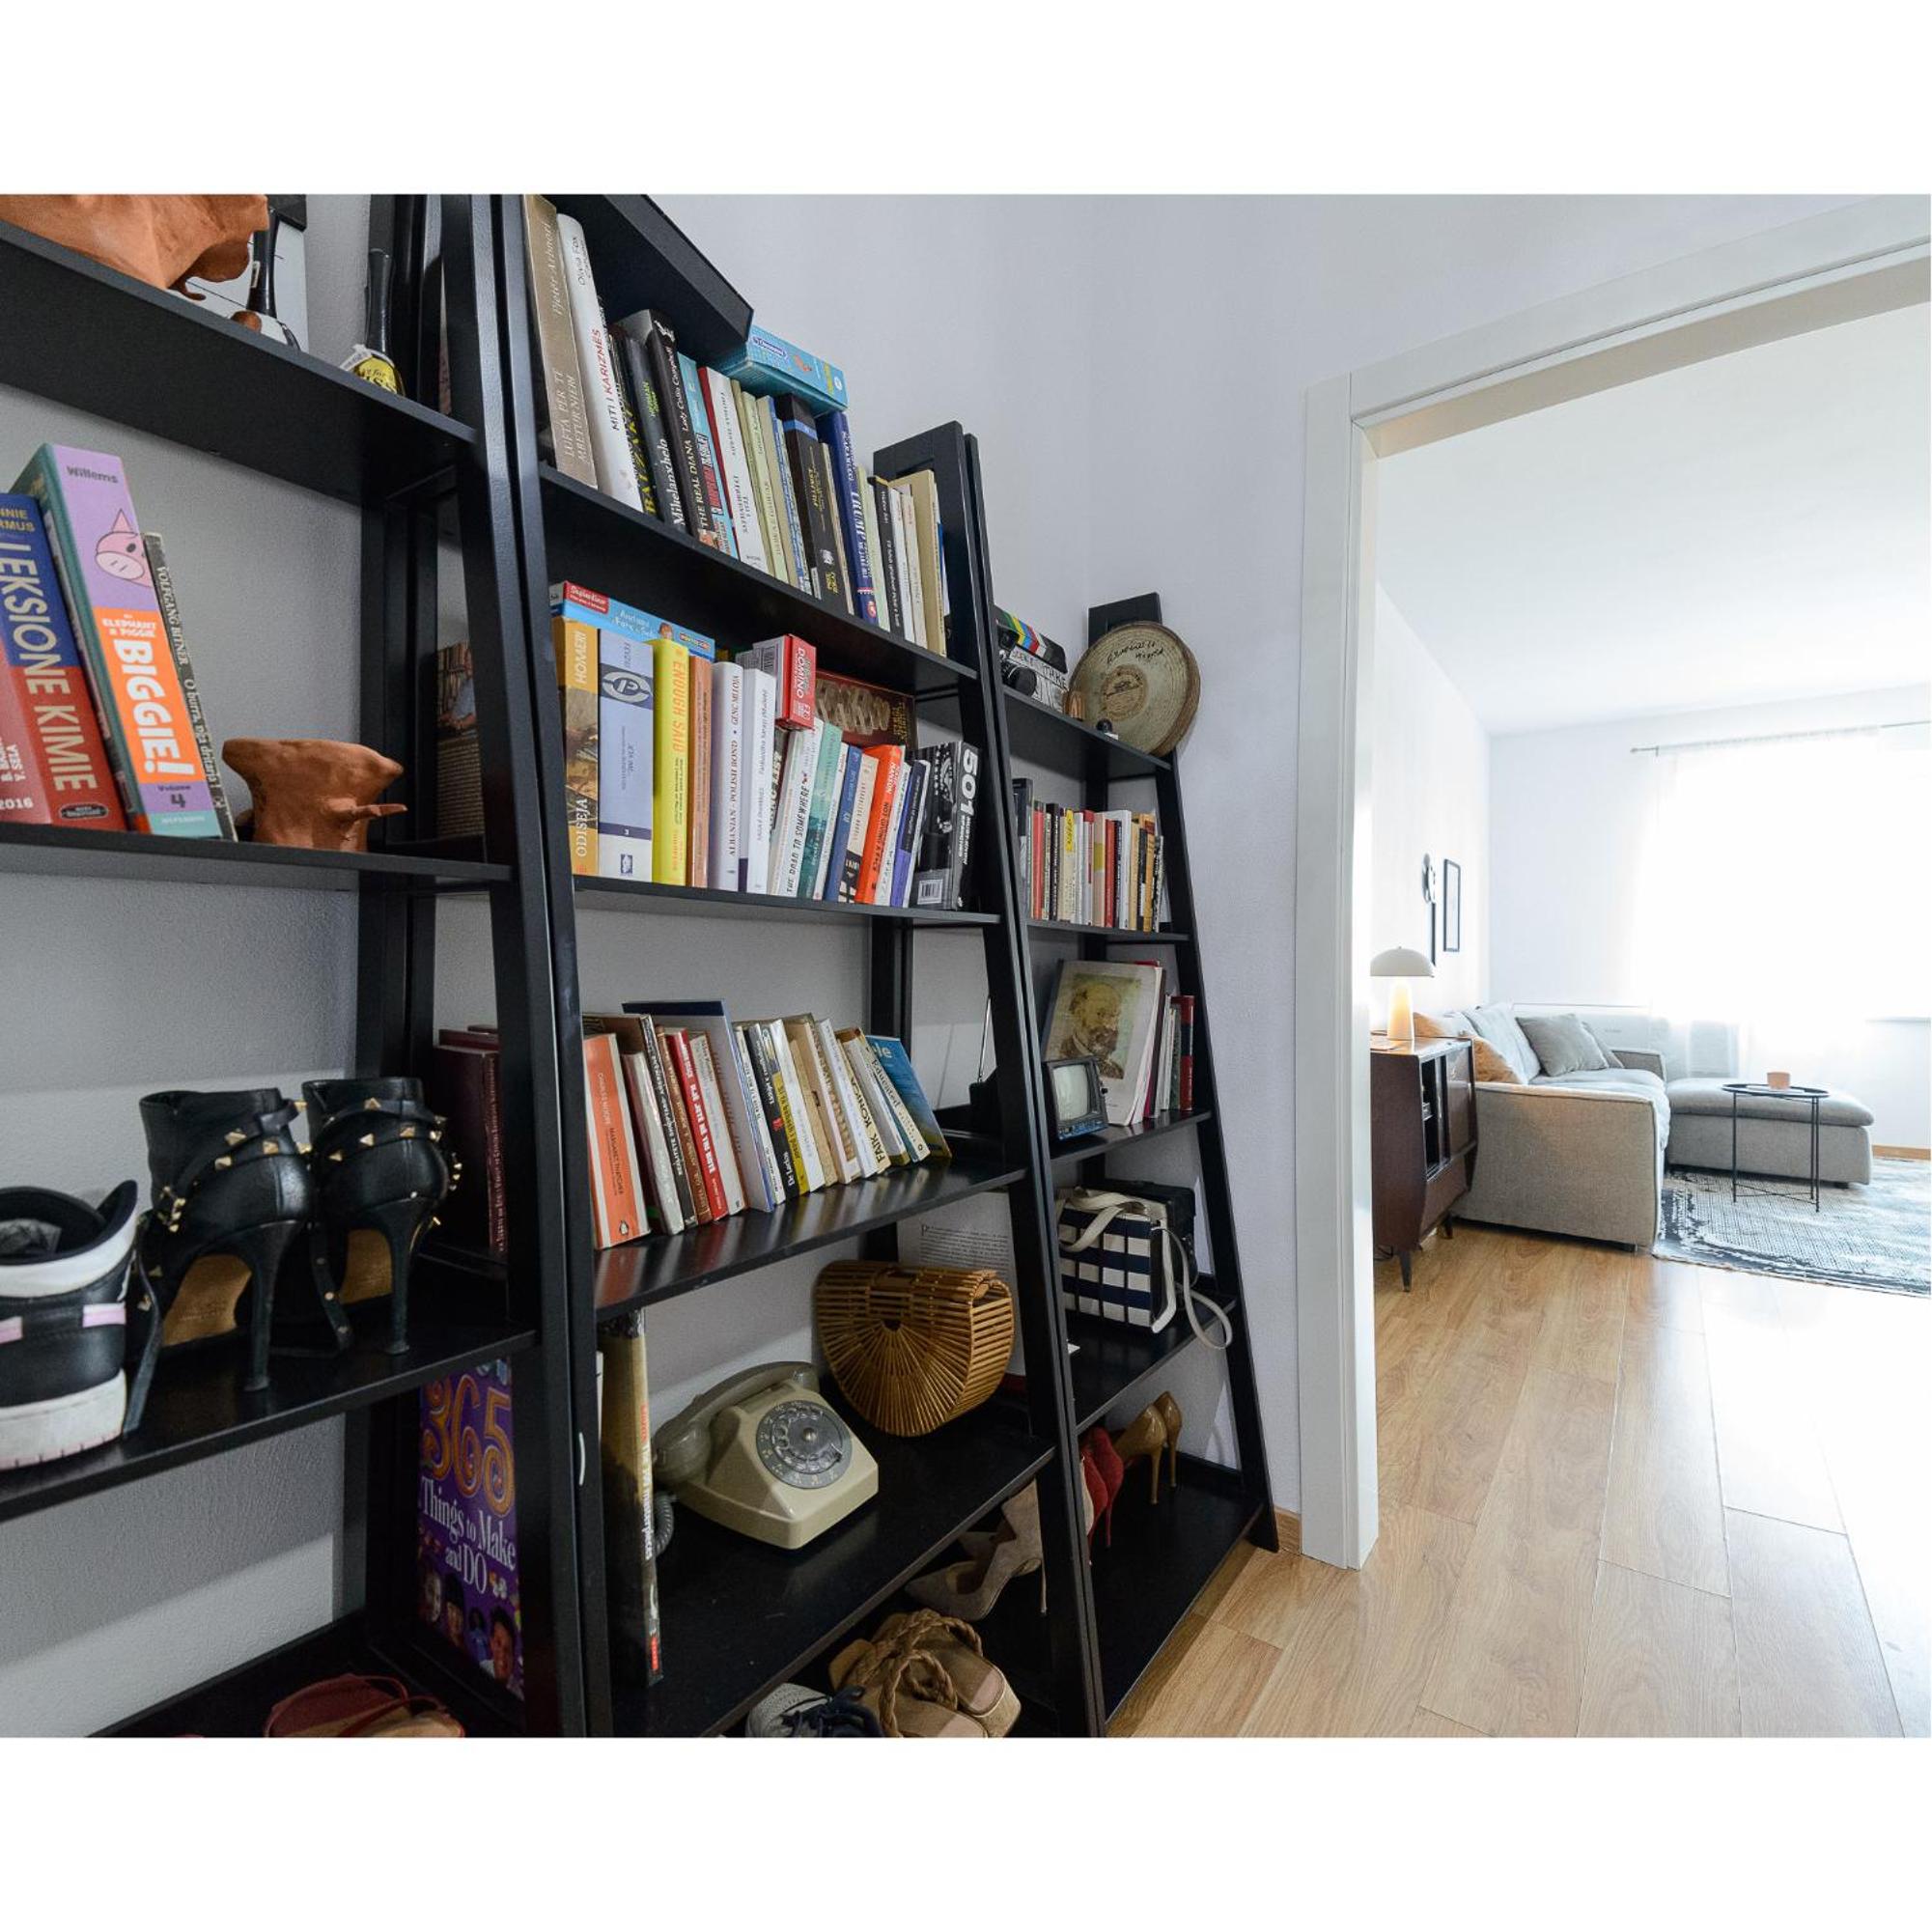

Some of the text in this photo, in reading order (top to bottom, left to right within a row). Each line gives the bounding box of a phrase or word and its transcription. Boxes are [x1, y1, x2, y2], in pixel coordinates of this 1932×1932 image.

[590, 328, 614, 395] KARIZMËS
[559, 417, 574, 458] LUFTA
[605, 404, 621, 432] MITI
[66, 465, 119, 484] Willems
[683, 438, 699, 475] DIANA
[689, 475, 704, 504] REAL
[850, 490, 867, 541] TRUMP
[694, 505, 709, 529] THE
[155, 565, 180, 627] VOLFGANG
[169, 626, 190, 666] BITNER
[574, 630, 588, 685] HOMERI
[796, 646, 805, 699] DOMINO
[114, 638, 196, 776] BIGGIE!
[672, 660, 686, 753] ENOUGH SAID
[34, 705, 98, 792] KIMIE
[0, 798, 34, 811] 2016
[171, 794, 185, 808] 4
[729, 739, 739, 857] ALBANIAN POLISH BOND
[961, 748, 978, 816] 501
[575, 798, 588, 857] ODISEJA
[793, 785, 809, 837] SOMEWHERE
[870, 1059, 901, 1107] Educated
[851, 1078, 886, 1163] FAIK KONICA
[421, 1373, 516, 1519] 365
[422, 1475, 518, 1572] Things to Make
[445, 1542, 489, 1596] and DO
